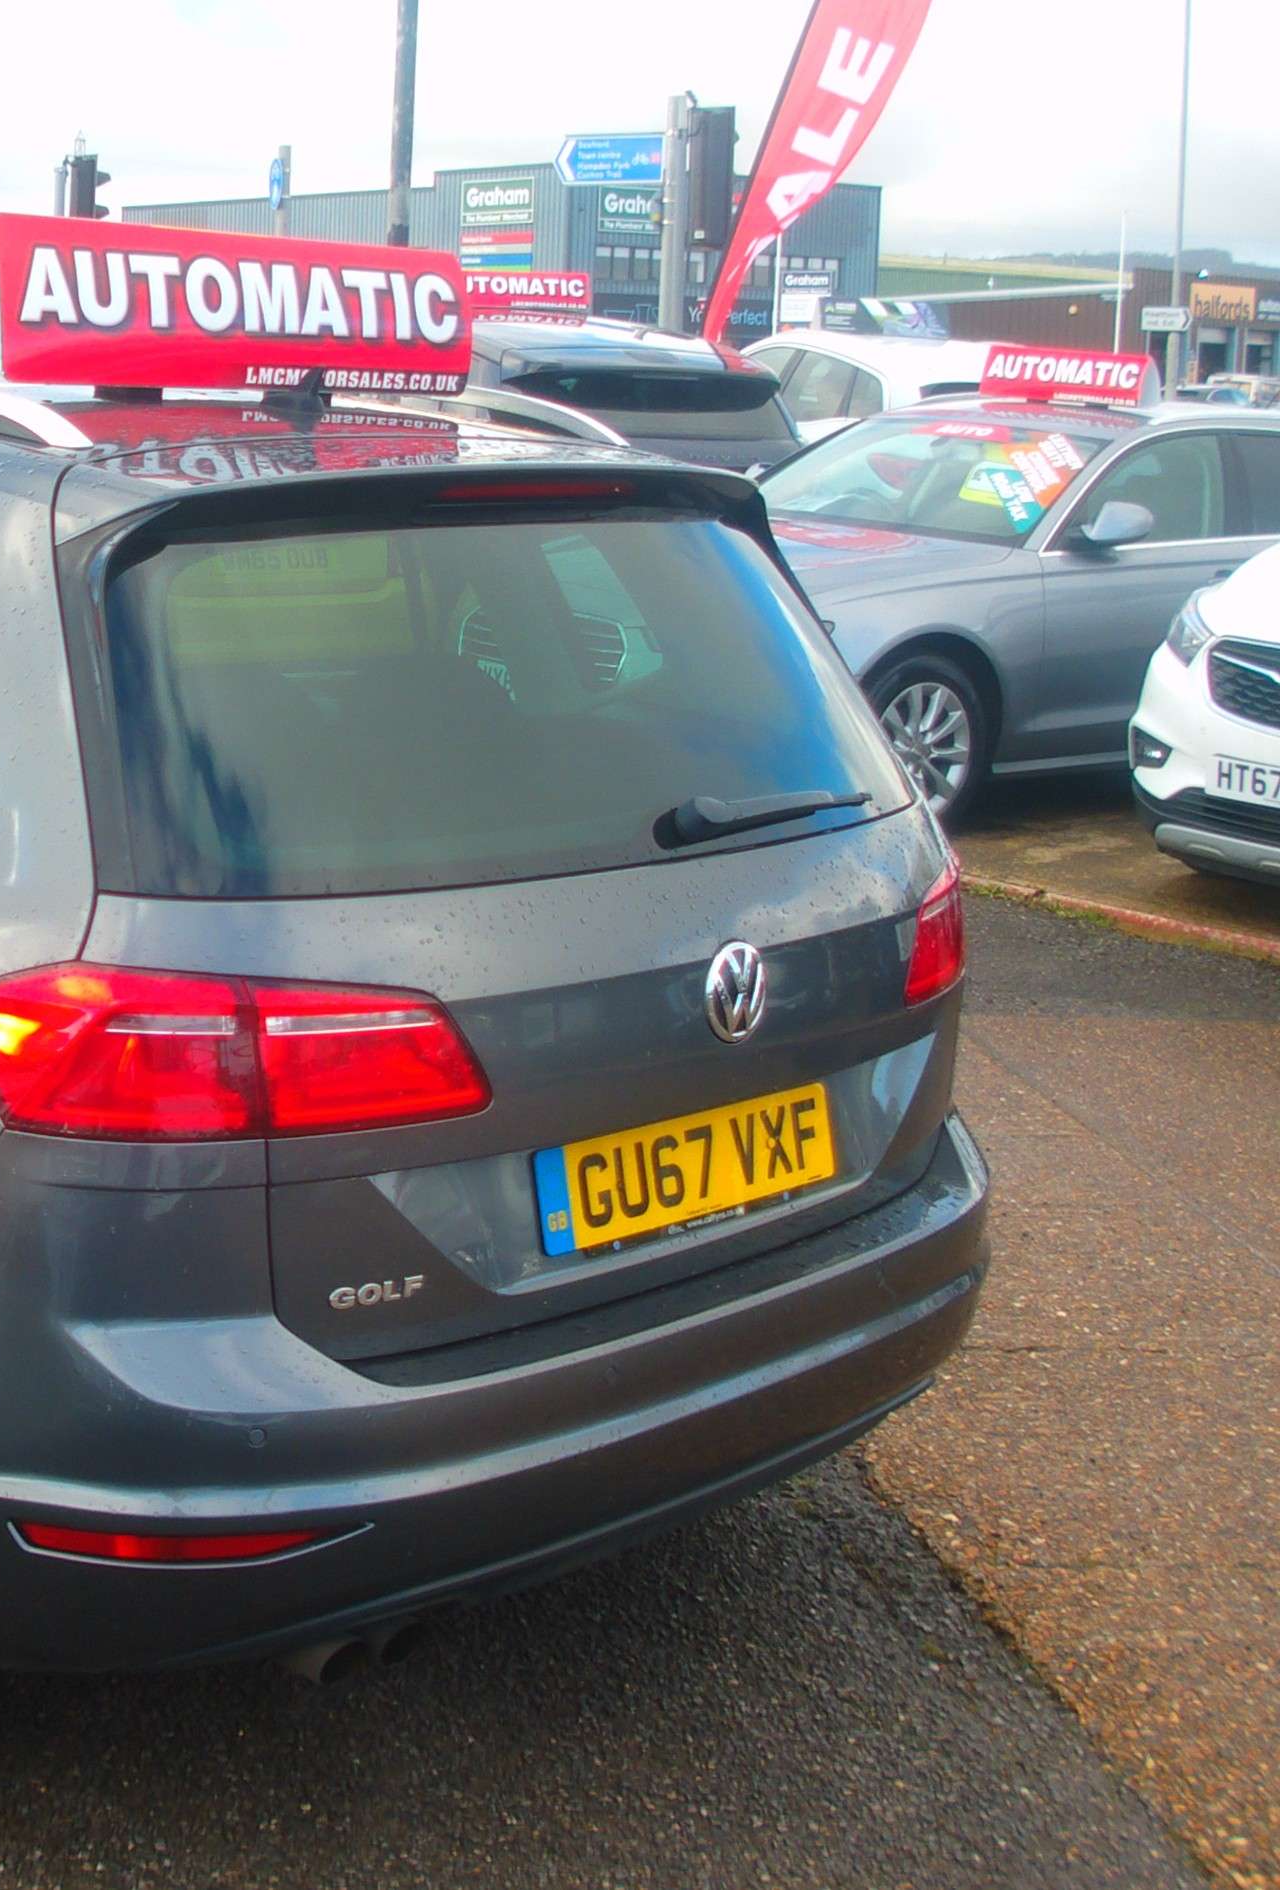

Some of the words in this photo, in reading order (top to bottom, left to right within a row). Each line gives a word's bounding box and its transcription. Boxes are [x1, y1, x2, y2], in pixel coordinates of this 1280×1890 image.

[765, 26, 896, 224] ALE
[466, 186, 530, 208] Graham
[604, 192, 652, 215] Grah
[19, 247, 459, 344] AUTOMATIC
[466, 275, 585, 298] TOMATIC
[785, 273, 829, 287] Graham
[1193, 293, 1251, 321] halfords
[245, 366, 460, 392] LMCMORSALES.CO.UK
[987, 353, 1140, 389] AUTOMATIC
[1217, 760, 1280, 800] HT67
[577, 1124, 713, 1230] GU67
[729, 1096, 817, 1187] VXF
[328, 1274, 424, 1310] GOLF
